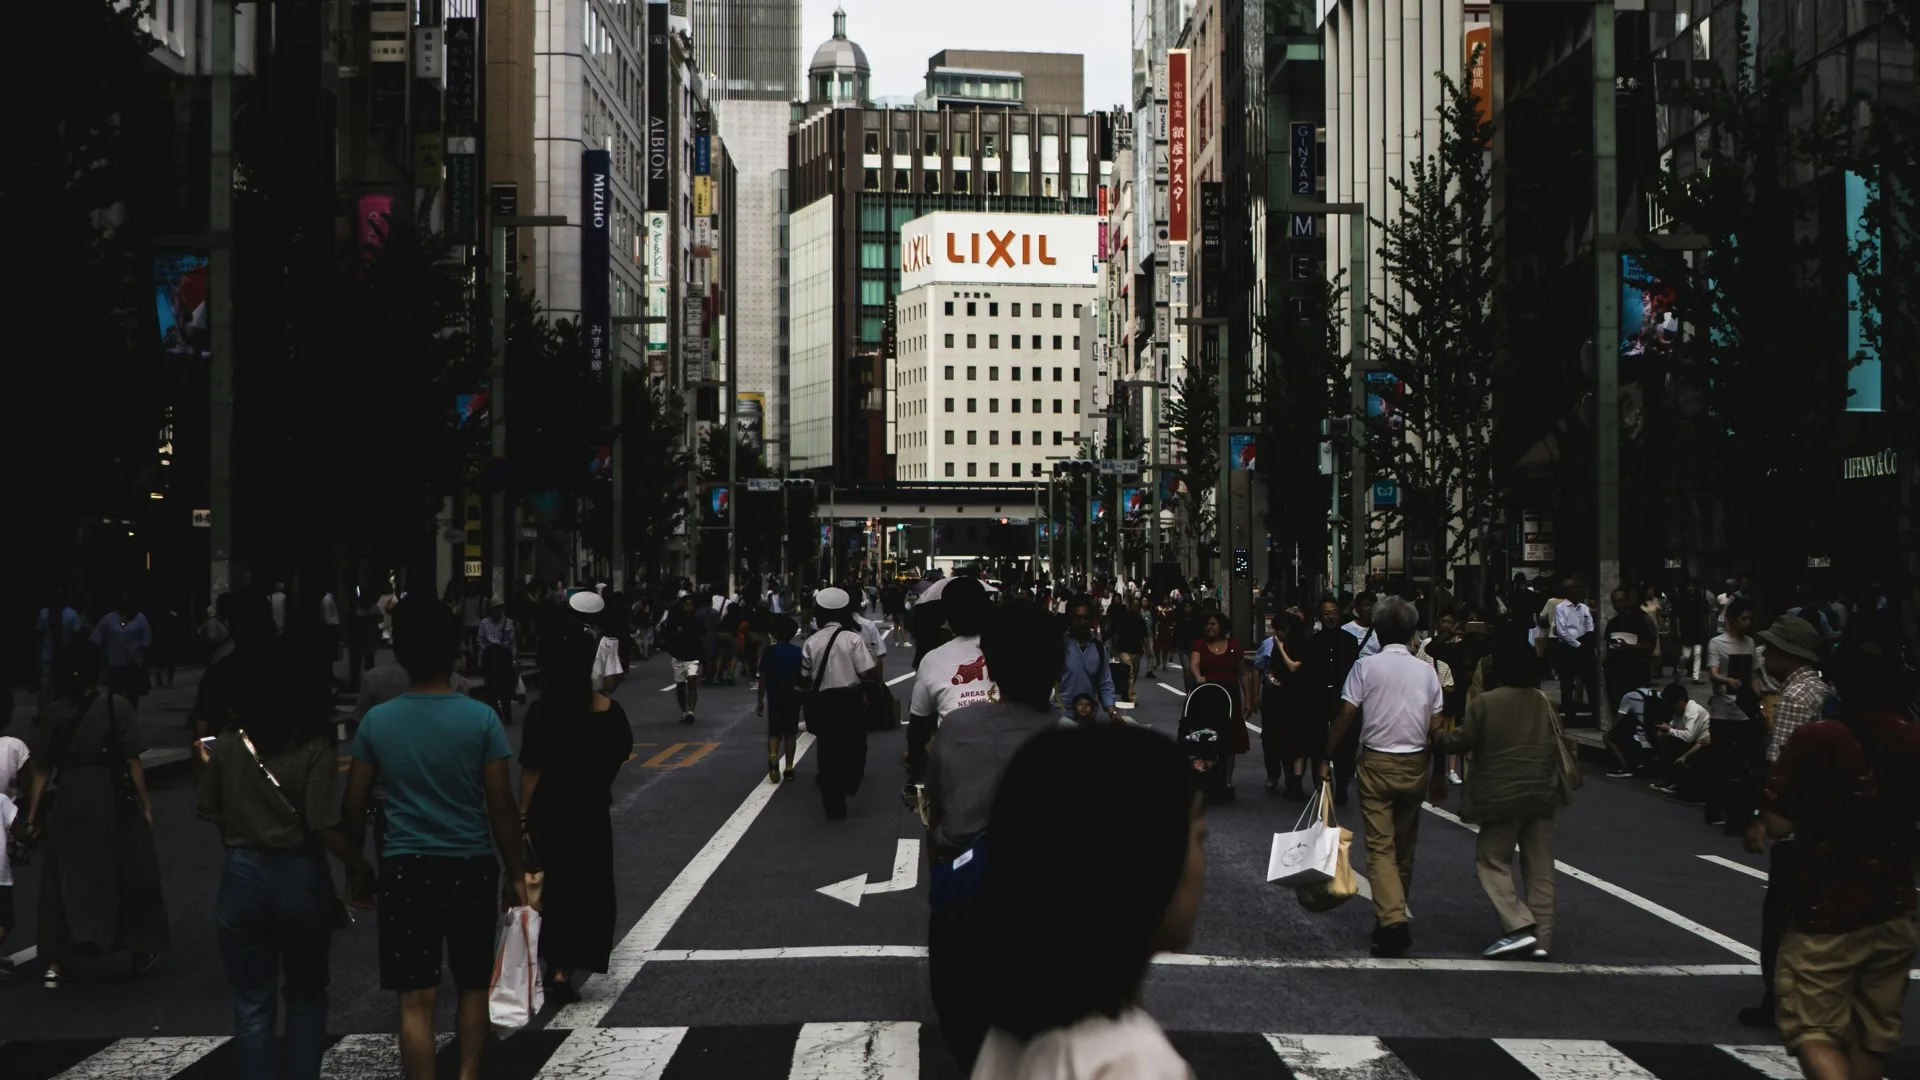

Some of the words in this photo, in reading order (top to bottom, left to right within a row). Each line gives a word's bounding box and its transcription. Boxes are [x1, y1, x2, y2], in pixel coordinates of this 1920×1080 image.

[464, 44, 473, 106] GINZA
[1173, 82, 1183, 119] 中国名菜
[651, 116, 665, 180] ALBION
[1172, 126, 1184, 214] 銀座アスター
[593, 173, 605, 228] MIZUHO
[902, 234, 932, 273] LIXIL
[946, 229, 1057, 268] LIXIL
[591, 324, 604, 384] みずほ銀
[960, 690, 985, 698] AREAS
